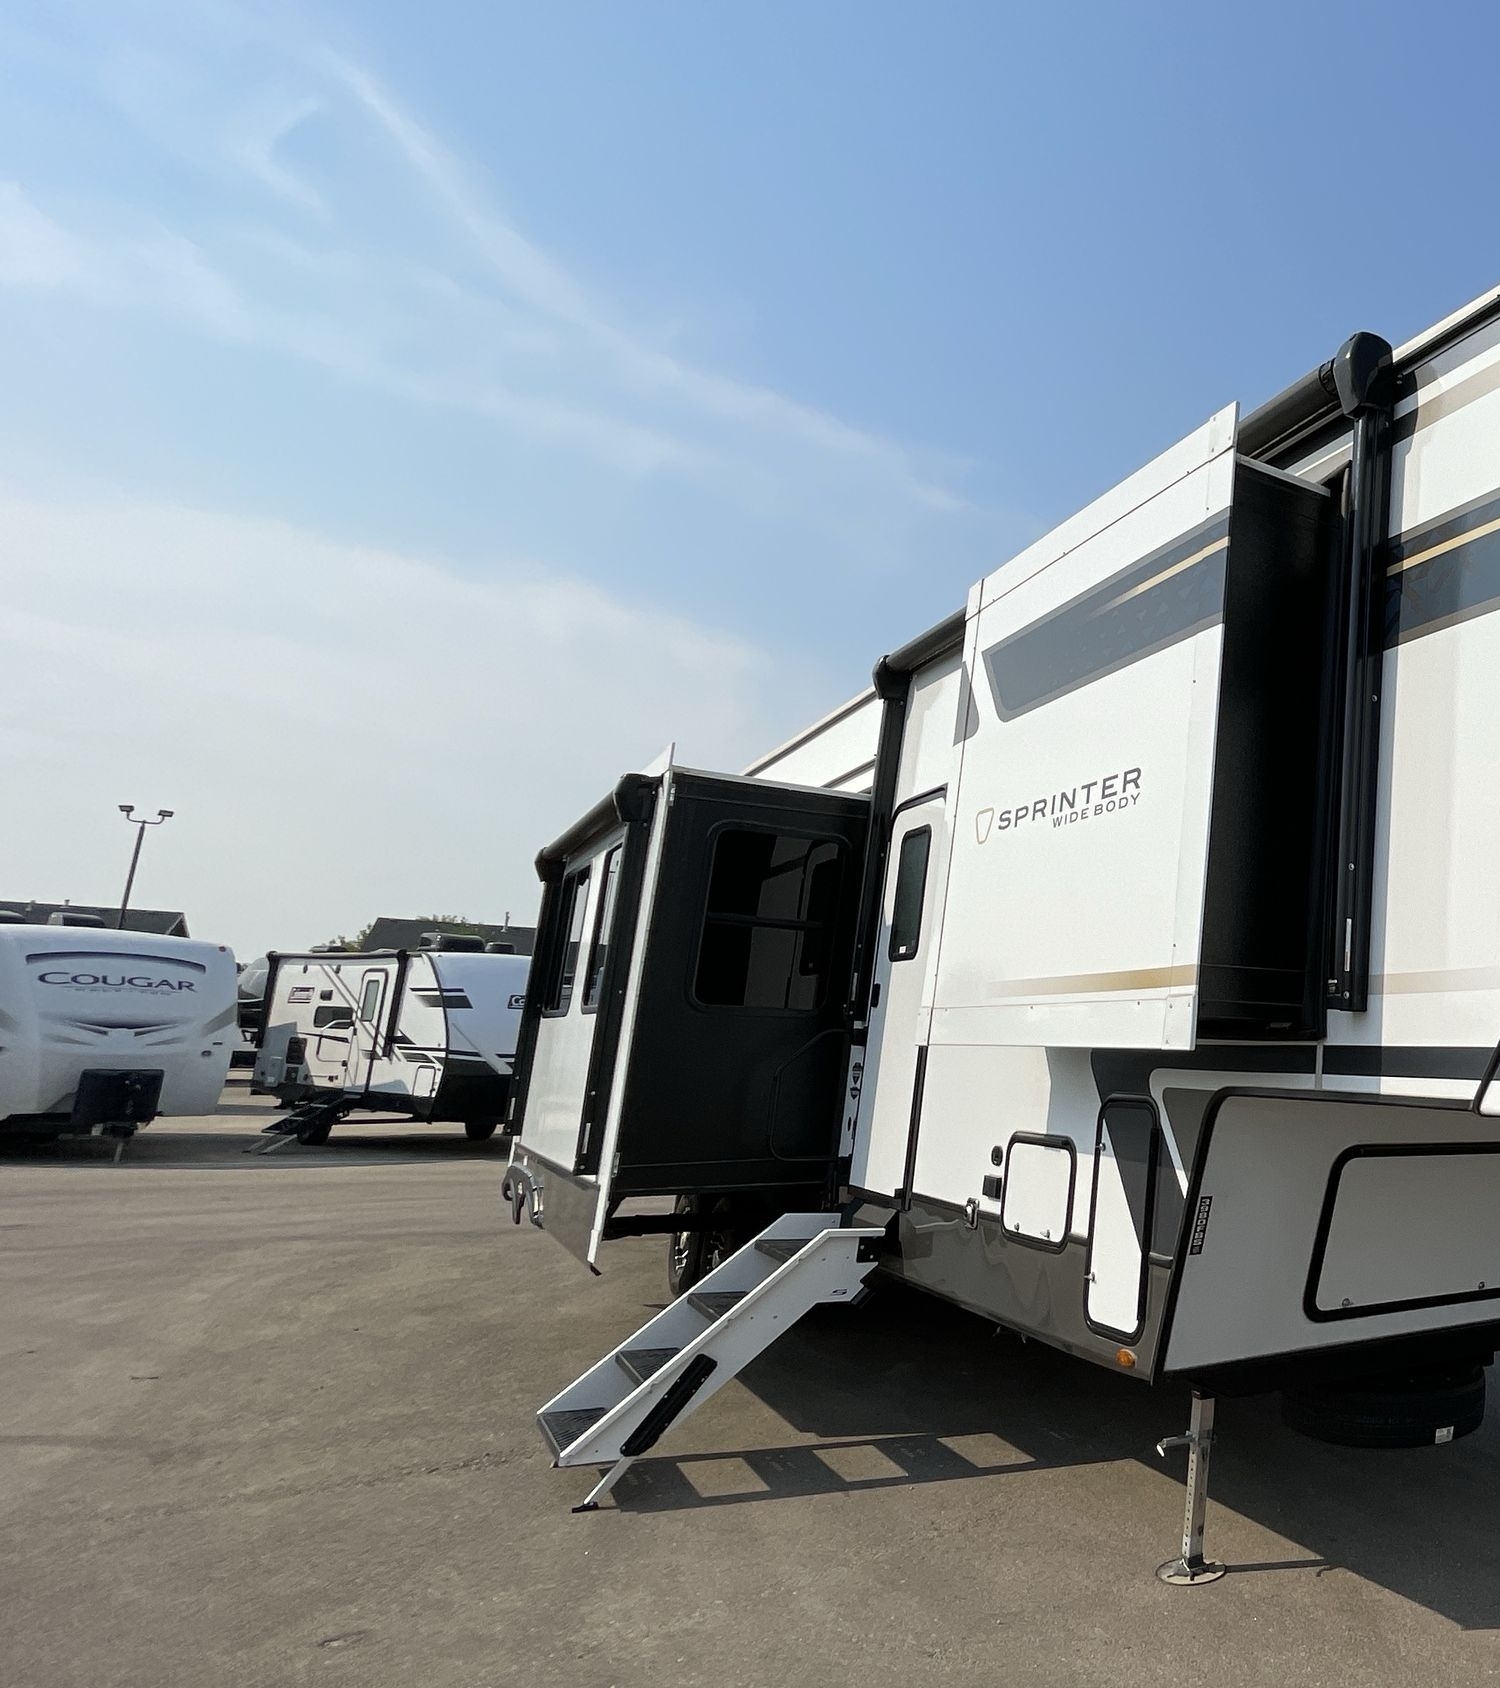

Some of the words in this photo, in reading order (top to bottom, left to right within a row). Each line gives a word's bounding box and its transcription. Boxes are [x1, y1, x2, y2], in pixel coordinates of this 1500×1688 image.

[998, 767, 1142, 830] SPRINTER
[1052, 808, 1089, 828] WIDE
[1094, 792, 1140, 816] BODY
[38, 971, 197, 992] COUGAR
